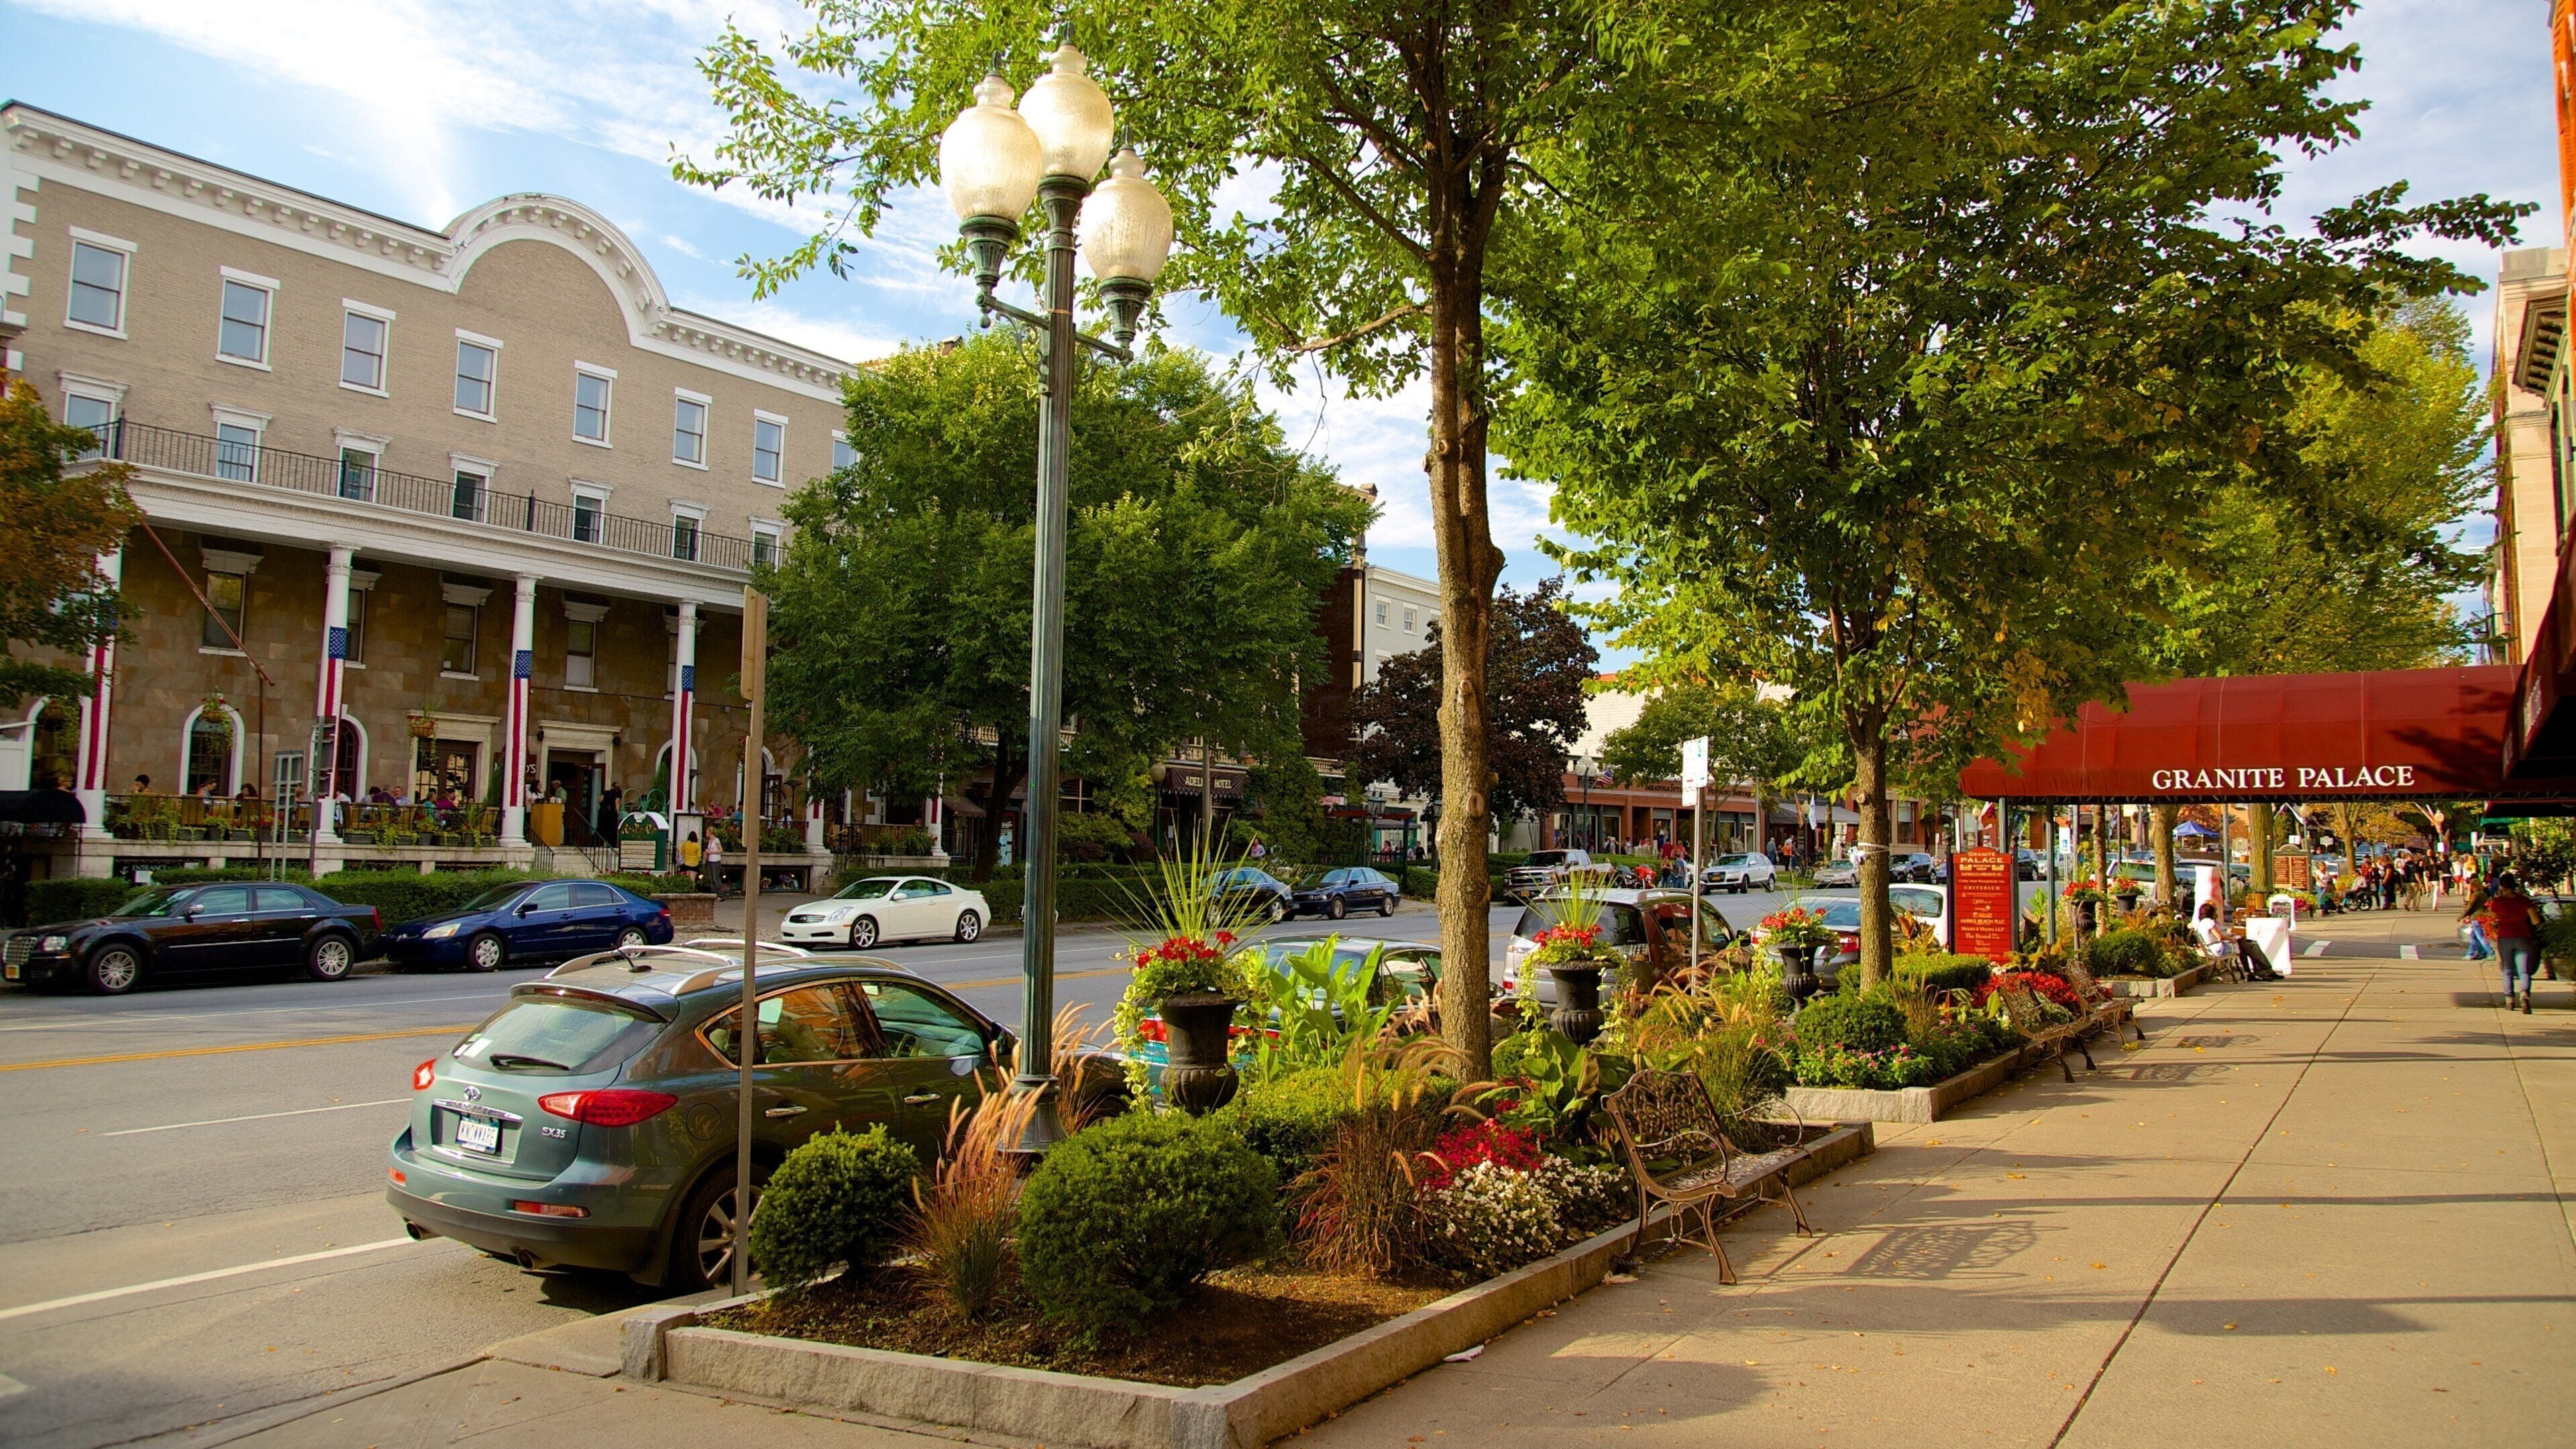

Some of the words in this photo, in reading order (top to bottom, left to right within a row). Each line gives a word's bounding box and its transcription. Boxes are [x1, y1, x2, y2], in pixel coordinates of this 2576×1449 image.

[2151, 767, 2285, 790] GRANITE
[2296, 765, 2416, 788] PALACE
[1214, 779, 1232, 789] HOTEL
[541, 1126, 567, 1138] EX35
